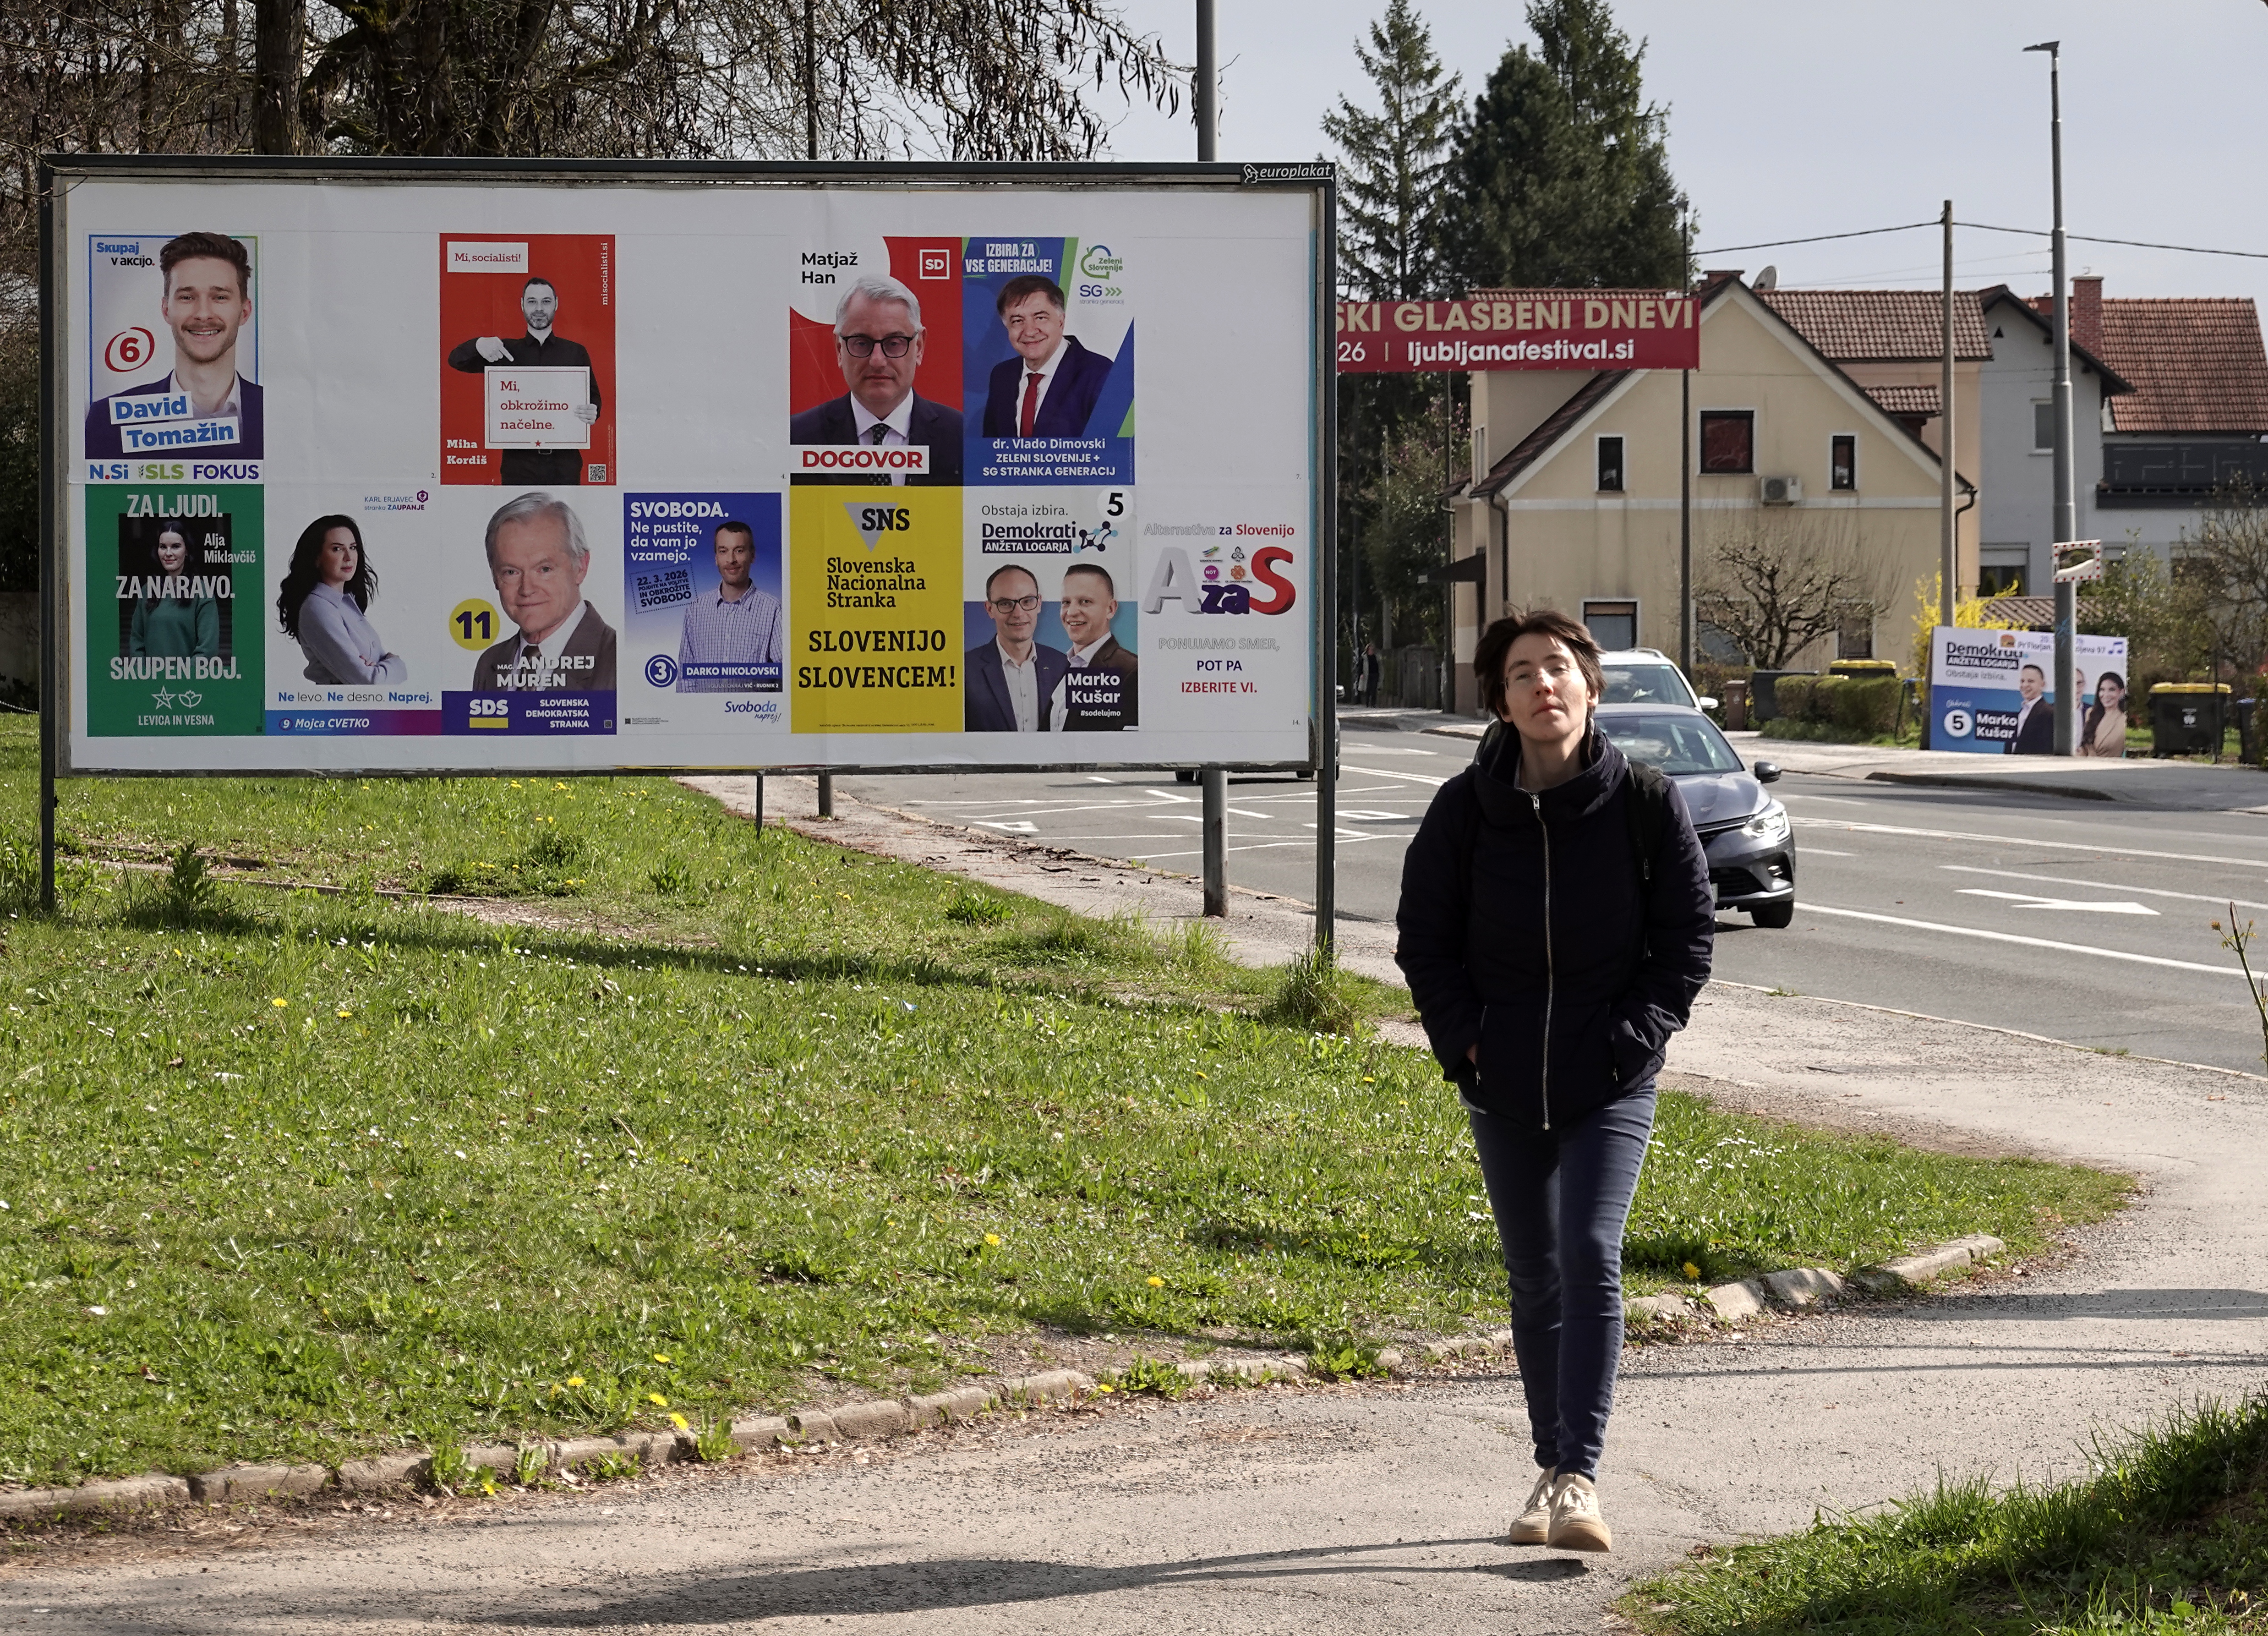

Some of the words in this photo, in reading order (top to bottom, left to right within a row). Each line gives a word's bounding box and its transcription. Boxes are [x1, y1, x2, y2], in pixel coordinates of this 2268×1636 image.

[1260, 164, 1331, 178] europlakat
[97, 241, 139, 255] Skupaj
[986, 244, 1019, 257] IZBIRA
[1022, 244, 1034, 257] ZA
[120, 255, 155, 268] akcijo.
[454, 253, 470, 263] Mi,
[472, 253, 521, 263] socialisti!
[802, 252, 858, 268] Matjaž
[925, 259, 944, 270] SD
[965, 259, 984, 272] VSE
[988, 259, 1052, 272] GENERACIJE!
[802, 271, 836, 284] Han
[1080, 285, 1102, 297] SG
[1394, 301, 1570, 332] GLASBENI
[1584, 300, 1693, 330] DNEVI
[120, 337, 140, 362] 6
[1408, 339, 1634, 366] ljubljanafestival.si
[500, 381, 519, 392] Mi,
[115, 396, 187, 420] David
[501, 399, 568, 410] obkrožimo
[500, 419, 554, 429] načelne.
[127, 423, 234, 448] Tomažin
[447, 439, 477, 448] Miha
[993, 438, 1009, 449] dr.
[1012, 438, 1046, 449] Vlado
[1050, 438, 1105, 449] Dimovski
[447, 455, 487, 465] Kordiš
[803, 451, 923, 468] DOGOVOR
[996, 454, 1031, 463] ZELENI
[1033, 454, 1091, 463] SLOVENIJE
[90, 464, 128, 479] N.Si
[145, 464, 184, 479] SLS
[193, 464, 259, 479] FOKUS
[983, 467, 998, 476] SG
[1000, 467, 1052, 476] STRANKA
[1055, 467, 1115, 476] GENERACIJ
[126, 495, 154, 517] ZA
[158, 495, 223, 517] LJUDI.
[630, 502, 729, 518] SVOBODA.
[982, 505, 1027, 517] Obstaja
[1032, 505, 1068, 516] izbira.
[1106, 492, 1124, 517] 5
[862, 508, 910, 531] SNS
[631, 521, 649, 533] Ne
[654, 521, 702, 536] pustite,
[982, 521, 1076, 538] Demokrati
[1144, 523, 1215, 536] Alternativa
[1219, 526, 1232, 535] za
[1236, 524, 1295, 538] Slovenijo
[204, 533, 225, 547] Alja
[631, 535, 648, 547] da
[652, 538, 680, 547] vam
[684, 535, 697, 549] jo
[984, 540, 1023, 552] ANŽETA
[1026, 542, 1069, 552] LOGARJA
[204, 550, 256, 564] Miklavčič
[631, 549, 691, 564] vzamejo.
[827, 558, 915, 573] Slovenska
[637, 576, 651, 586] 22.
[653, 575, 662, 583] 3.
[664, 569, 688, 581] 2026
[827, 575, 926, 591] Nacionalna
[115, 576, 142, 599] ZA
[148, 576, 235, 599] NARAVO.
[649, 584, 690, 596] OBKROŽITE
[641, 591, 691, 607] SVOBODO
[827, 592, 896, 608] Stranka
[456, 611, 490, 639] 11
[809, 630, 946, 652] SLOVENIJO
[1159, 638, 1235, 650] PONUJAMO
[1239, 638, 1280, 651] SMER,
[110, 657, 191, 680] SKUPEN
[196, 657, 241, 679] BOJ.
[517, 656, 595, 669] ANDREJ
[1197, 660, 1222, 671] POT
[1226, 660, 1242, 671] PA
[655, 662, 667, 680] 3
[687, 667, 720, 675] DARKO
[721, 667, 778, 675] NIKOLOVSKI
[798, 666, 956, 688] SLOVENCEM!
[497, 673, 566, 687] MUREN
[1068, 673, 1120, 686] Marko
[1181, 682, 1236, 693] IZBERITE
[1241, 682, 1257, 693] VI.
[279, 692, 294, 701] Ne
[298, 692, 324, 701] levo.
[328, 692, 343, 701] Ne
[347, 692, 385, 701] desno.
[389, 692, 432, 704] Naprej.
[1071, 690, 1120, 703] Kušar
[469, 699, 508, 715] SDS
[725, 701, 777, 712] Svoboda
[138, 715, 170, 726] LEVICA
[173, 715, 182, 726] IN
[185, 715, 214, 726] VESNA
[283, 720, 290, 728] 9
[295, 719, 325, 730] Mojca
[328, 718, 369, 728] CVETKO
[754, 713, 781, 723] naprej!
[1953, 716, 1963, 730] 5
[1977, 713, 2017, 726] Marko
[1976, 726, 2015, 739] Kušar
